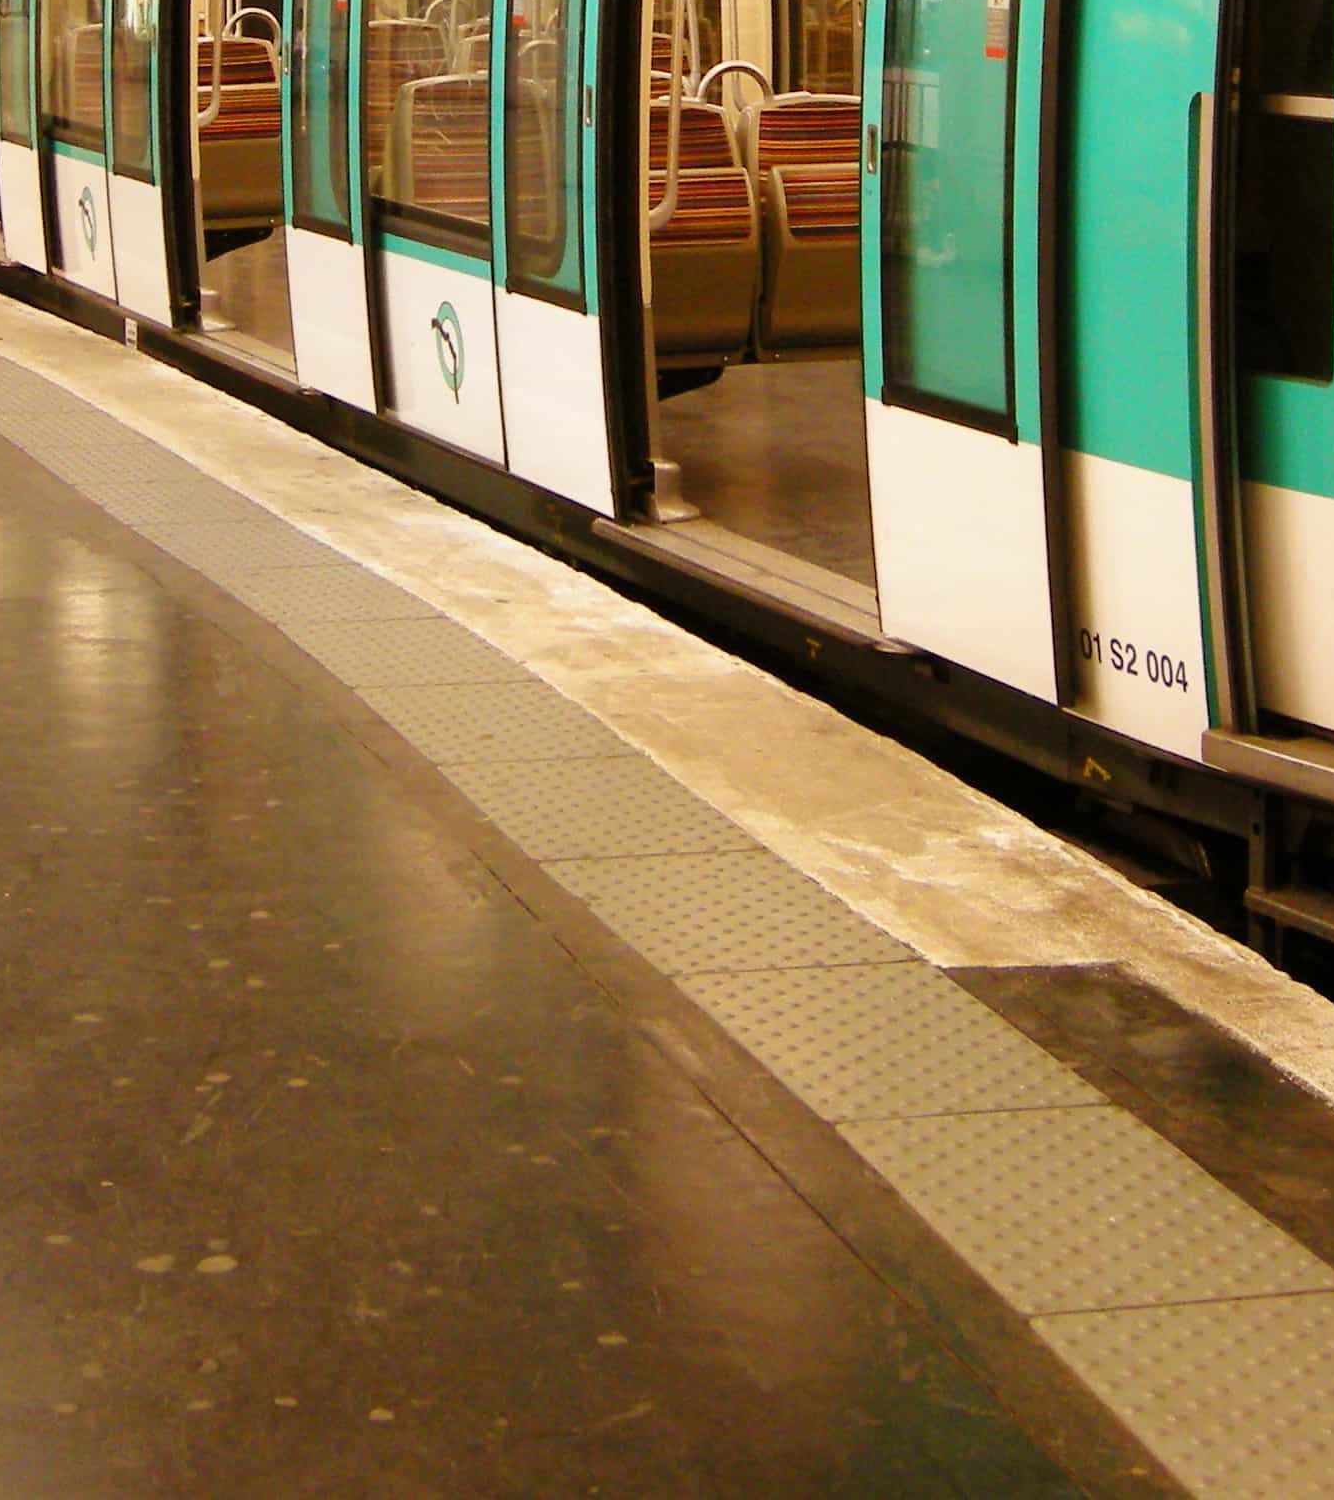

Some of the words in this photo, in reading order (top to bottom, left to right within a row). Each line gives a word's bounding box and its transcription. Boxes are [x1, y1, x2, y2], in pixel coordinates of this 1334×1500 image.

[1080, 628, 1103, 664] 01
[1110, 638, 1138, 676] S2
[1147, 650, 1188, 692] 004
